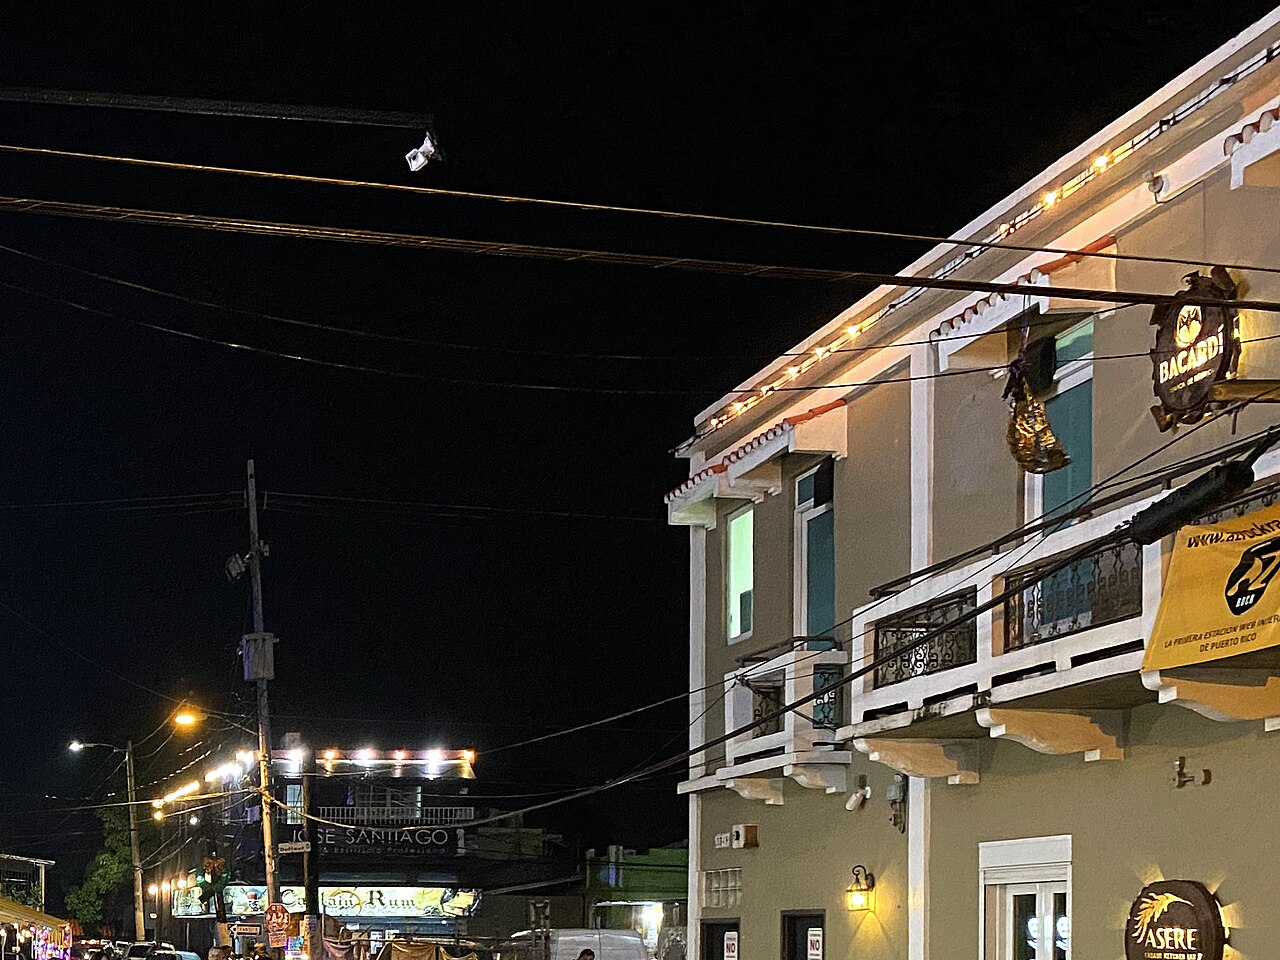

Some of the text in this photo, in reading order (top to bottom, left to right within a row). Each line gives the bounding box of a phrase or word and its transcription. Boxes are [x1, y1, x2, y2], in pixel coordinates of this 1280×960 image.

[1159, 323, 1224, 384] BACARDÍ
[1164, 640, 1173, 649] LA
[1173, 635, 1202, 646] PRIMERA
[1204, 627, 1237, 640] ESTACION
[1239, 620, 1256, 631] WEB
[1200, 632, 1257, 652] DE PUERTO RICO
[345, 828, 449, 846] SANTIAGO
[280, 888, 416, 910] Catain Rum
[726, 943, 736, 953] NO
[810, 939, 820, 951] NO
[1144, 927, 1198, 950] ASERE
